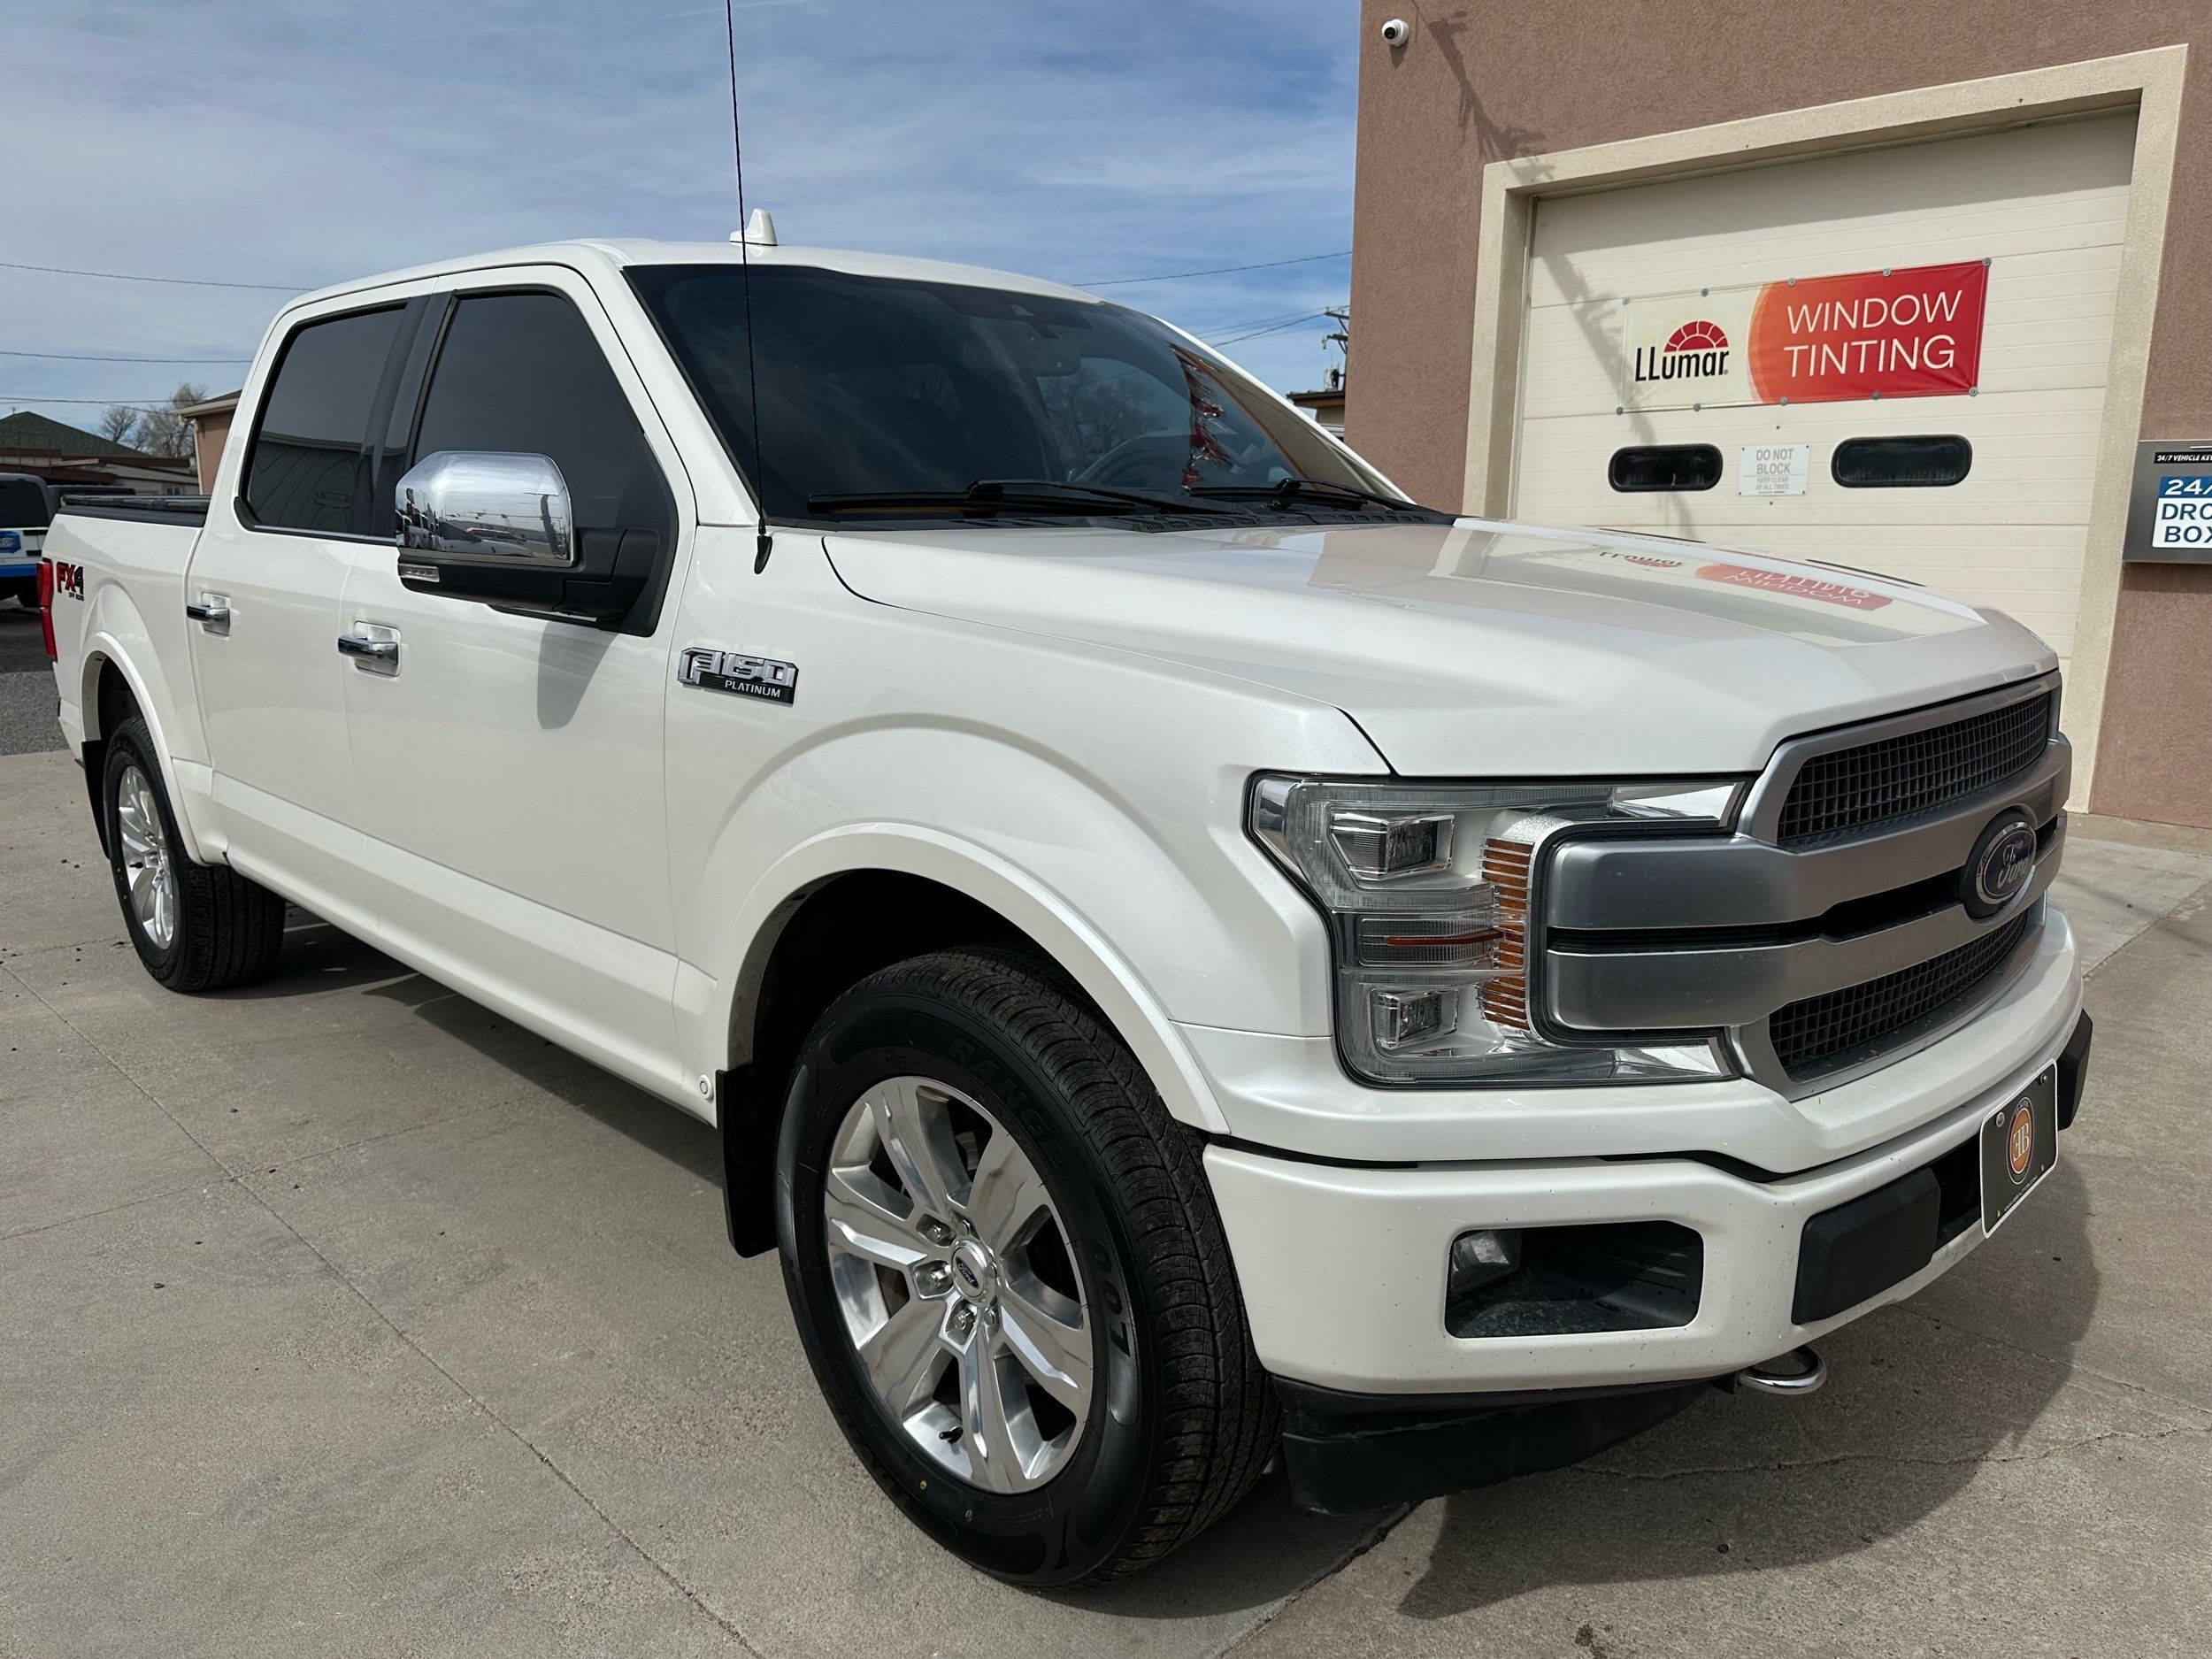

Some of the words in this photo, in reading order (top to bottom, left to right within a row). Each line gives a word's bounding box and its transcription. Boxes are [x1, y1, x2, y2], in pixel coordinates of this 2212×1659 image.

[1786, 289, 1962, 334] WINDOW
[1635, 346, 1729, 382] LLumar
[1782, 334, 1956, 378] TINTING
[1756, 449, 1770, 461] DO
[1773, 448, 1794, 460] NOT
[1756, 463, 1791, 475] BLOCK
[56, 561, 84, 595] FX4
[725, 680, 781, 698] PLATINUM
[1997, 841, 2032, 888] Ford
[1088, 1239, 1131, 1358] 007
